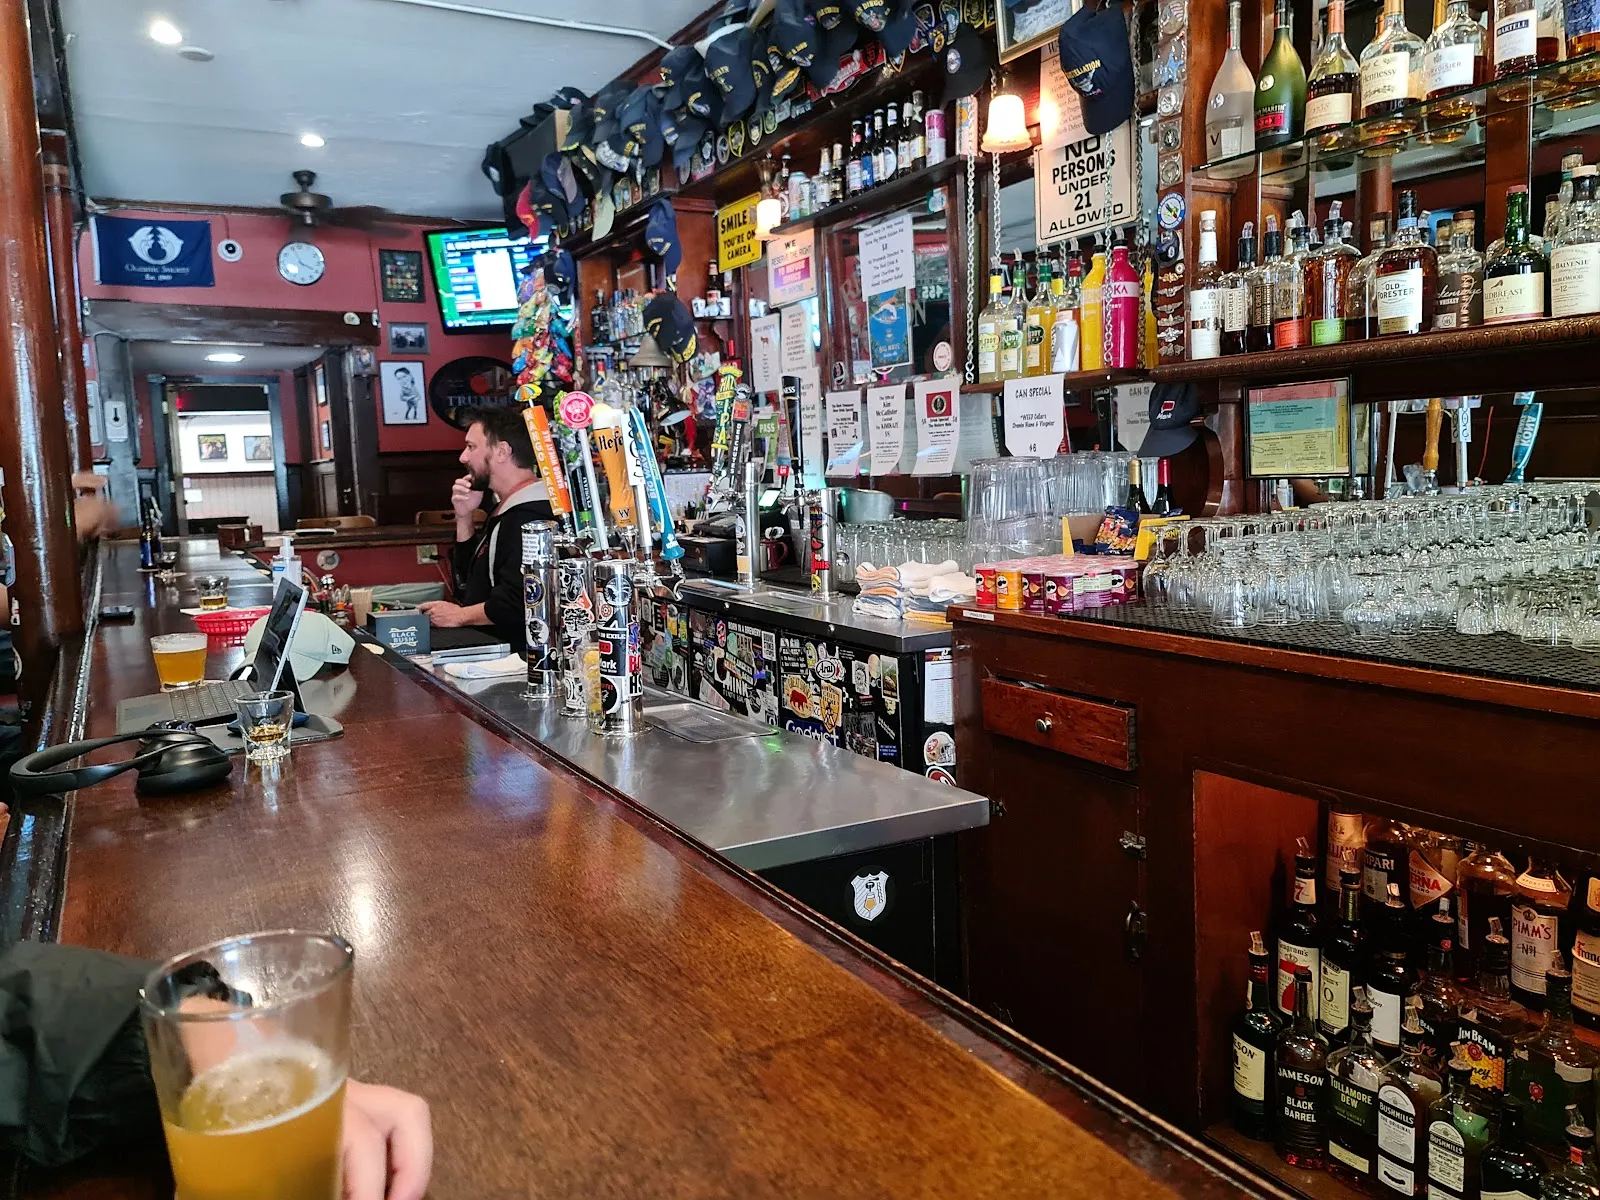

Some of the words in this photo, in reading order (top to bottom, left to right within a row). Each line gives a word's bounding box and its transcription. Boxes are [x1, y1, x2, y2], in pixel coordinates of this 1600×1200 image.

[1429, 62, 1462, 77] RVOISIER
[1064, 135, 1101, 162] NO
[1052, 149, 1116, 185] PERSONS
[1074, 190, 1093, 212] 21
[720, 209, 747, 235] SMILE
[723, 233, 745, 250] YOU'RE
[784, 239, 797, 250] WE
[727, 243, 752, 261] CAMERA
[1377, 287, 1415, 300] FORESTER
[1494, 305, 1504, 314] 12
[1015, 388, 1028, 399] CAN
[1029, 385, 1052, 398] SPECIAL
[759, 422, 775, 433] PASS
[599, 430, 624, 453] Hefe
[730, 423, 742, 474] DESCHUTES
[391, 631, 416, 639] BLACK
[600, 658, 617, 670] ark
[1365, 853, 1395, 871] PARI
[1294, 885, 1305, 901] 7
[1512, 918, 1552, 941] PIMM'S
[1234, 1041, 1256, 1060] ESON
[1458, 1027, 1471, 1040] JIM
[1471, 1029, 1496, 1056] BEAM
[1278, 1067, 1325, 1087] JAMESON
[1472, 1065, 1492, 1080] ney
[1330, 1075, 1373, 1106] TULLAMORE
[1286, 1095, 1314, 1111] BLACK
[1340, 1093, 1359, 1109] DEW
[1284, 1106, 1317, 1123] BARREL
[1379, 1101, 1415, 1125] BUSHMILLS
[1429, 1132, 1464, 1156] BUSHMILLS
